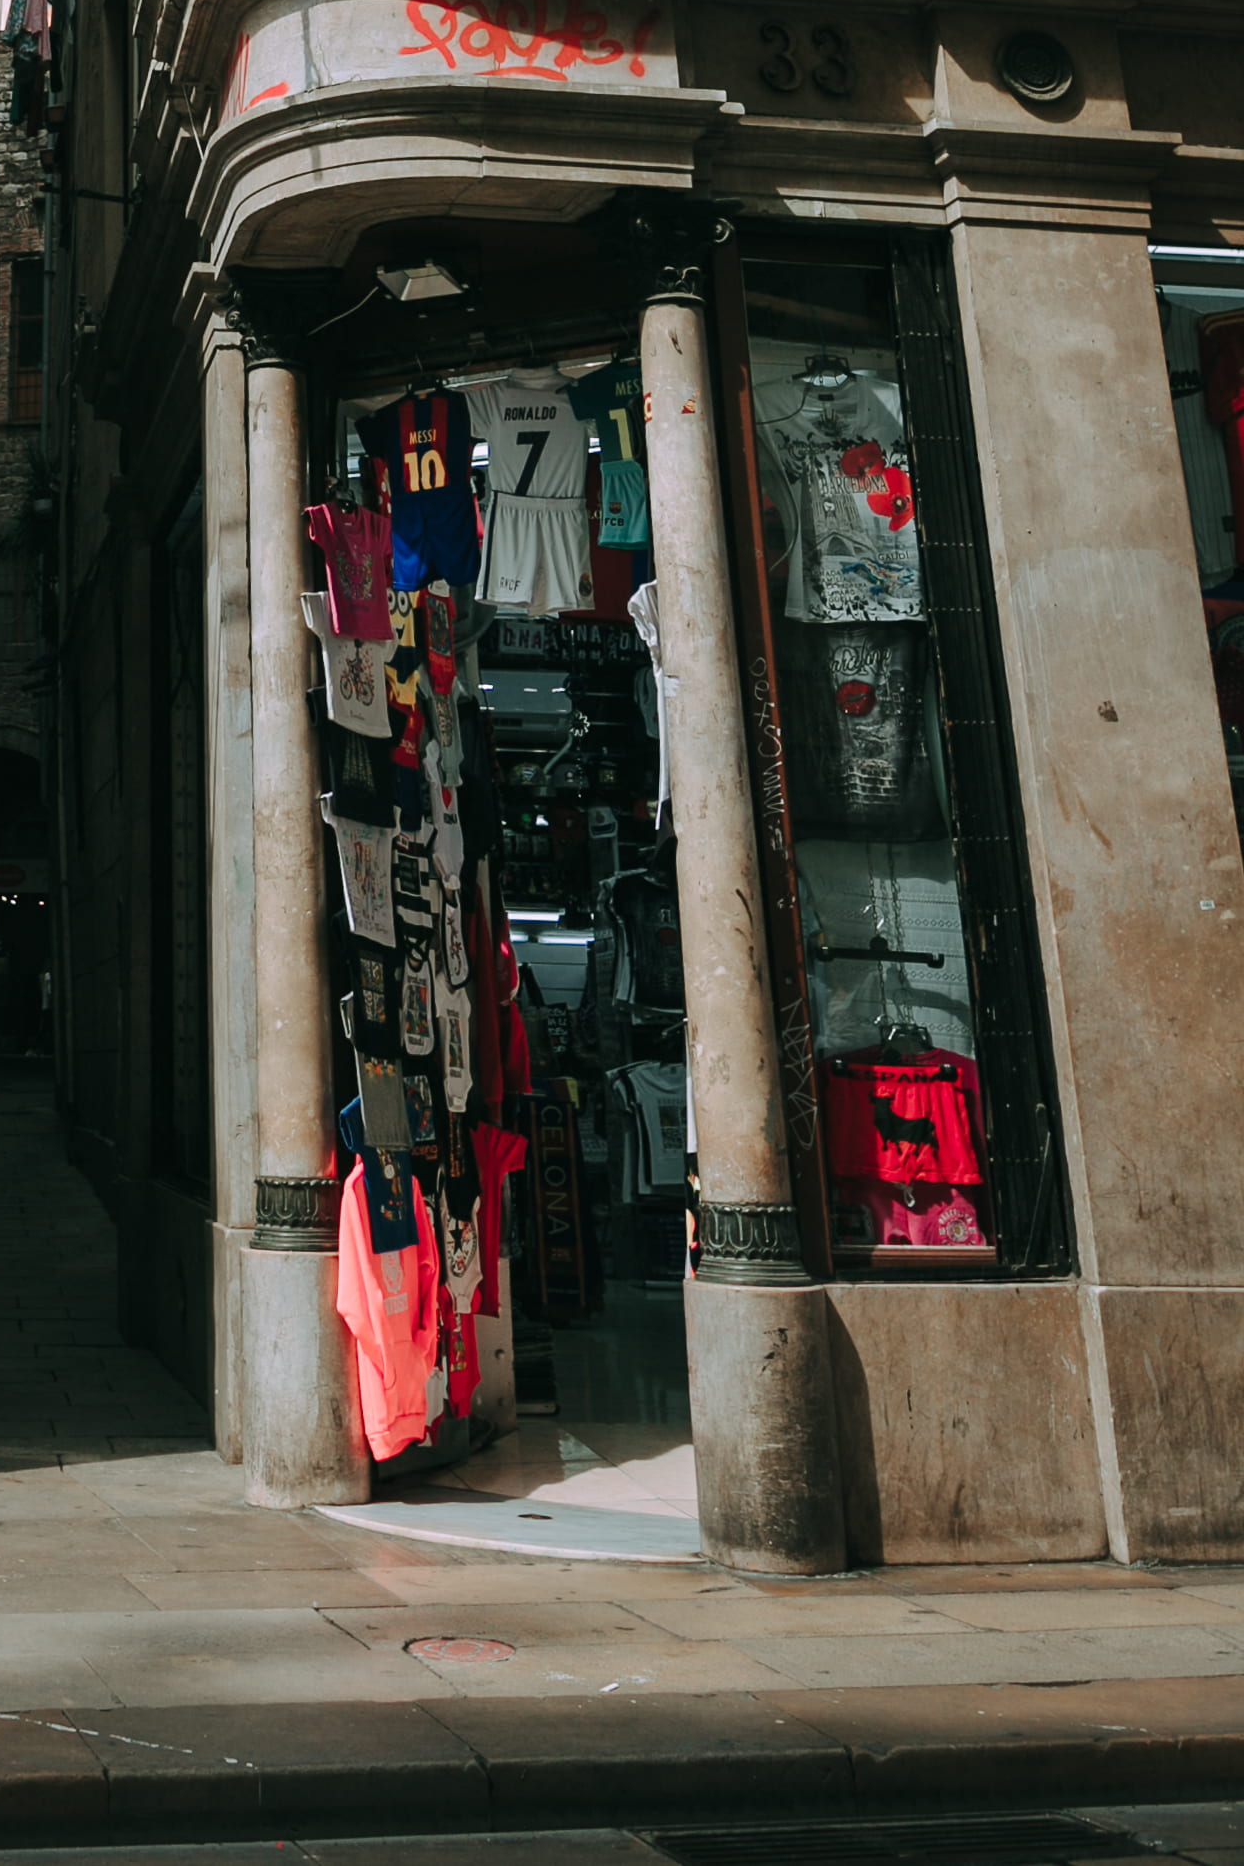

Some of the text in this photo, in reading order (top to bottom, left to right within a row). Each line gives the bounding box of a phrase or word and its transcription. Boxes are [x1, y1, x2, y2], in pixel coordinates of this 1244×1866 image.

[759, 19, 854, 97] 33
[504, 406, 556, 421] RONALDO
[409, 429, 437, 445] MESSI
[404, 449, 446, 492] 10
[516, 431, 550, 496] 7
[820, 475, 889, 495] BARCELONA
[604, 517, 625, 527] FCB
[540, 1104, 570, 1236] CELONA
